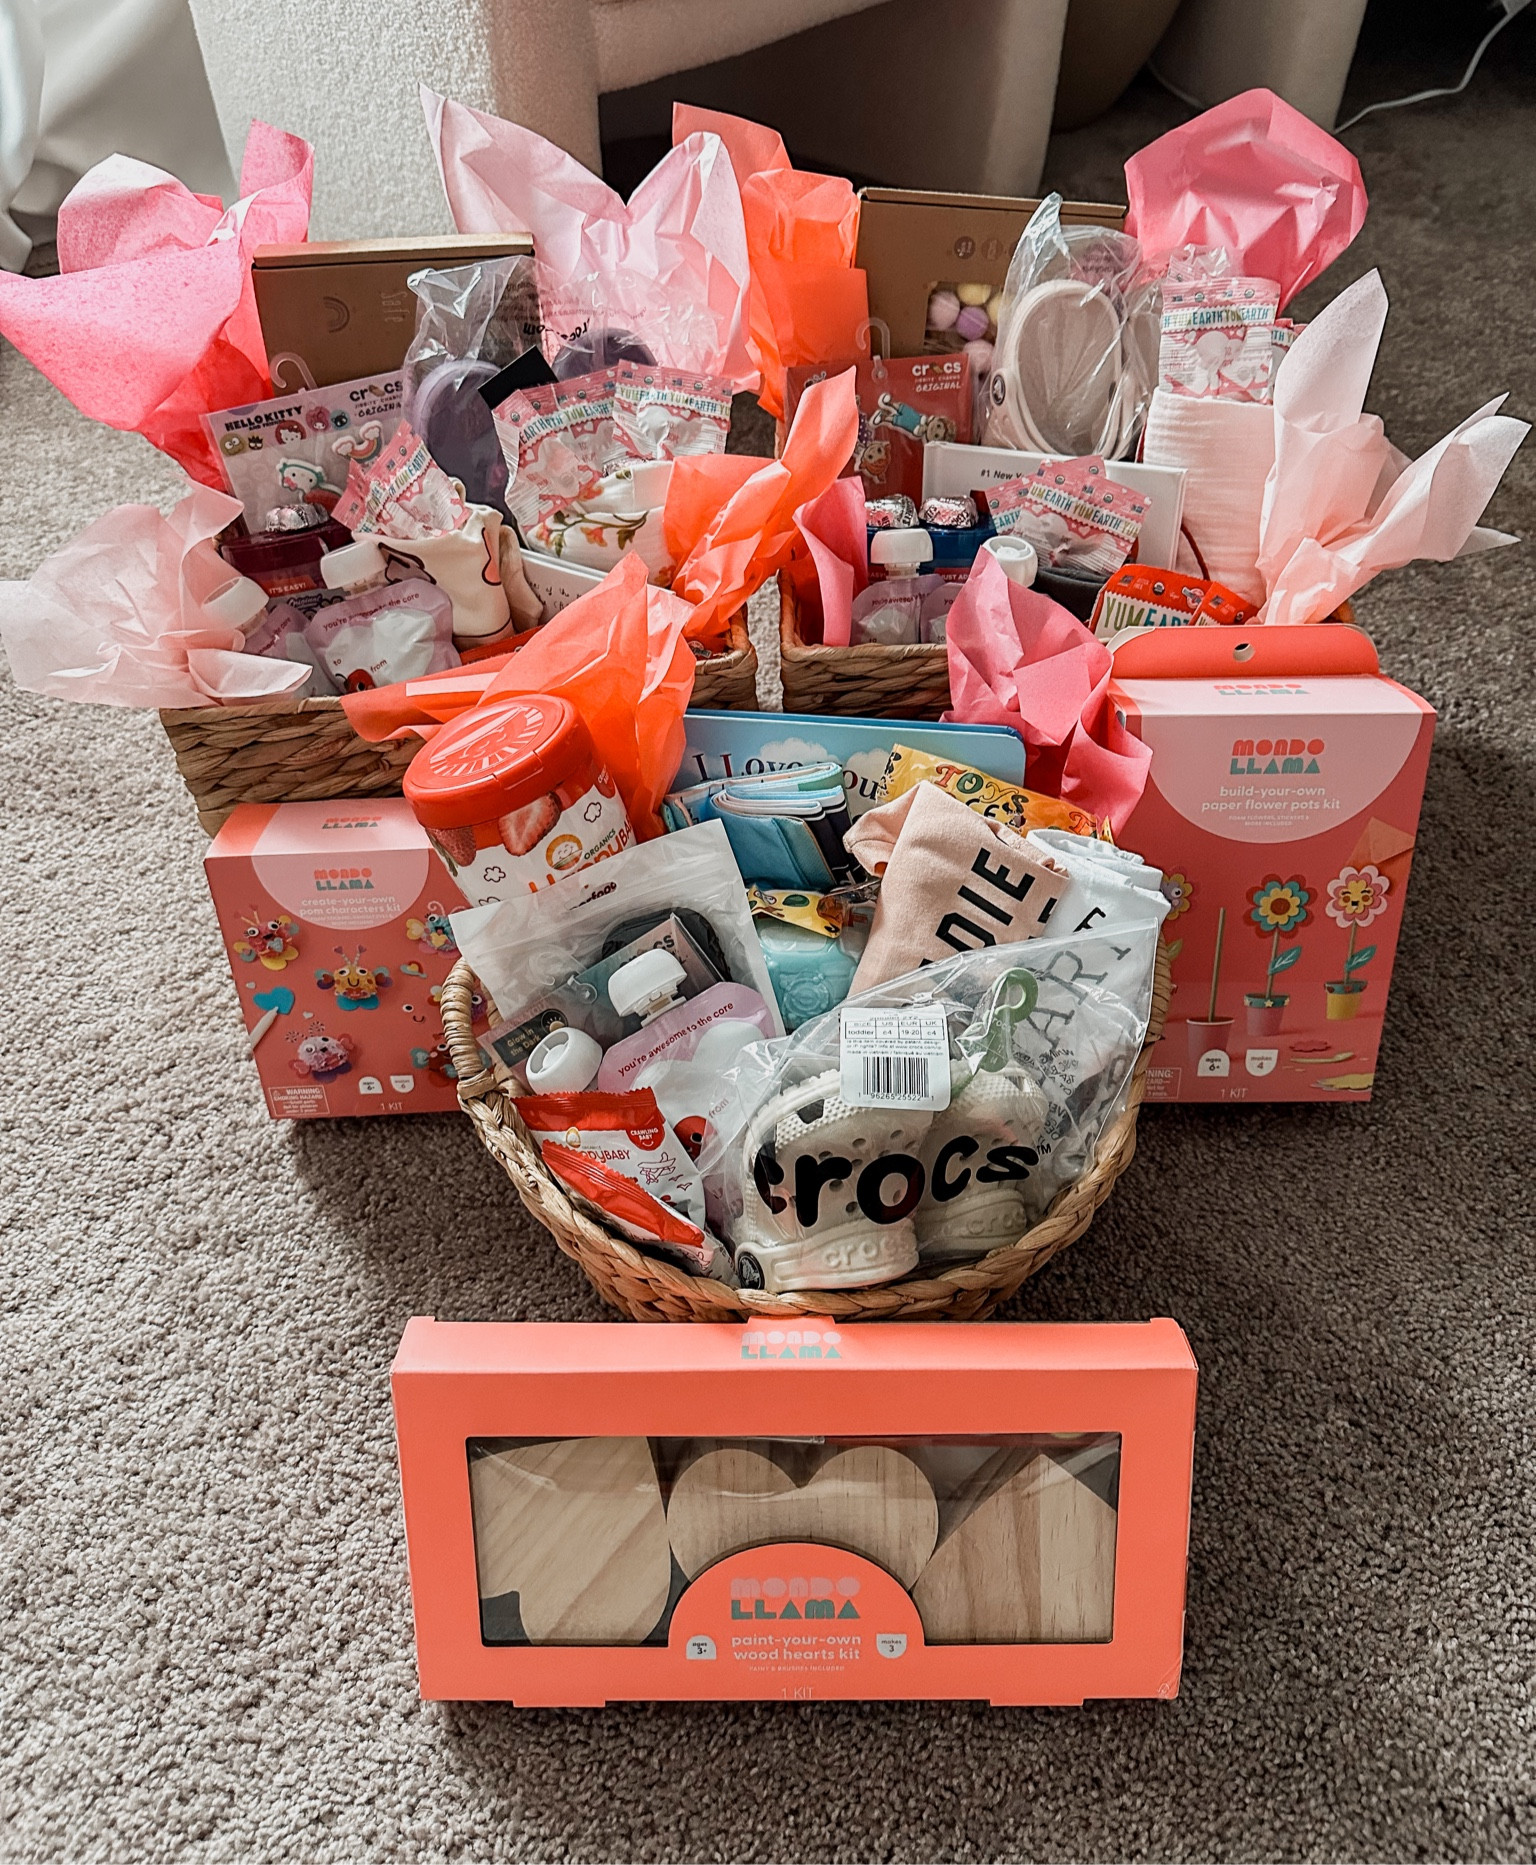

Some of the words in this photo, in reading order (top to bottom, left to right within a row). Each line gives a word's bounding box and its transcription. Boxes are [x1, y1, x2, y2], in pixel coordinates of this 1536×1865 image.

[916, 381, 962, 393] ORIGINAL
[358, 402, 402, 417] ORIGINA
[224, 415, 263, 431] HELLO
[263, 405, 303, 423] KITTY
[980, 469, 991, 478] #1
[993, 470, 1012, 481] New
[1073, 504, 1122, 530] YUMEARTH
[323, 617, 347, 632] you're
[402, 592, 420, 604] core
[333, 657, 342, 667] to
[370, 658, 388, 674] from
[1231, 738, 1325, 756] MONDO
[691, 753, 712, 781] I
[1229, 757, 1321, 775] LLAMA
[1219, 786, 1326, 798] build-your-own
[1201, 801, 1242, 812] paper
[1245, 799, 1288, 811] flower
[1290, 800, 1320, 812] pots
[1323, 799, 1341, 810] kit
[321, 822, 380, 830] LLAMA
[583, 828, 617, 860] ORGANICS
[313, 867, 373, 880] MONDO
[315, 879, 375, 891] LLAMA
[301, 896, 396, 907] create-your-own
[919, 847, 1036, 968] DIE
[299, 908, 324, 917] pom
[325, 905, 385, 914] characters
[386, 903, 401, 912] kit
[507, 1034, 526, 1047] Glow
[525, 1028, 534, 1037] in
[617, 1053, 648, 1077] you're
[648, 1029, 688, 1059] awesome
[686, 1022, 698, 1033] to
[697, 1013, 713, 1028] the
[713, 1002, 734, 1019] core
[510, 1046, 524, 1057] the
[523, 1035, 541, 1049] Dark
[1257, 1062, 1264, 1070] 4
[1229, 1088, 1248, 1098] KIT
[388, 1102, 403, 1111] KIT
[707, 1098, 729, 1120] from
[630, 1128, 659, 1137] CRAWLING
[741, 1330, 842, 1345] MONDO
[741, 1345, 842, 1359] LLAMA
[730, 1576, 861, 1598] MONDO
[731, 1599, 861, 1620] LLAMA
[731, 1633, 862, 1648] paint-your-own
[733, 1648, 779, 1660] wood
[783, 1648, 835, 1660] hearts
[839, 1648, 861, 1660] kit
[888, 1645, 895, 1653] 3
[781, 1687, 787, 1699] 1
[793, 1686, 815, 1699] KIT
